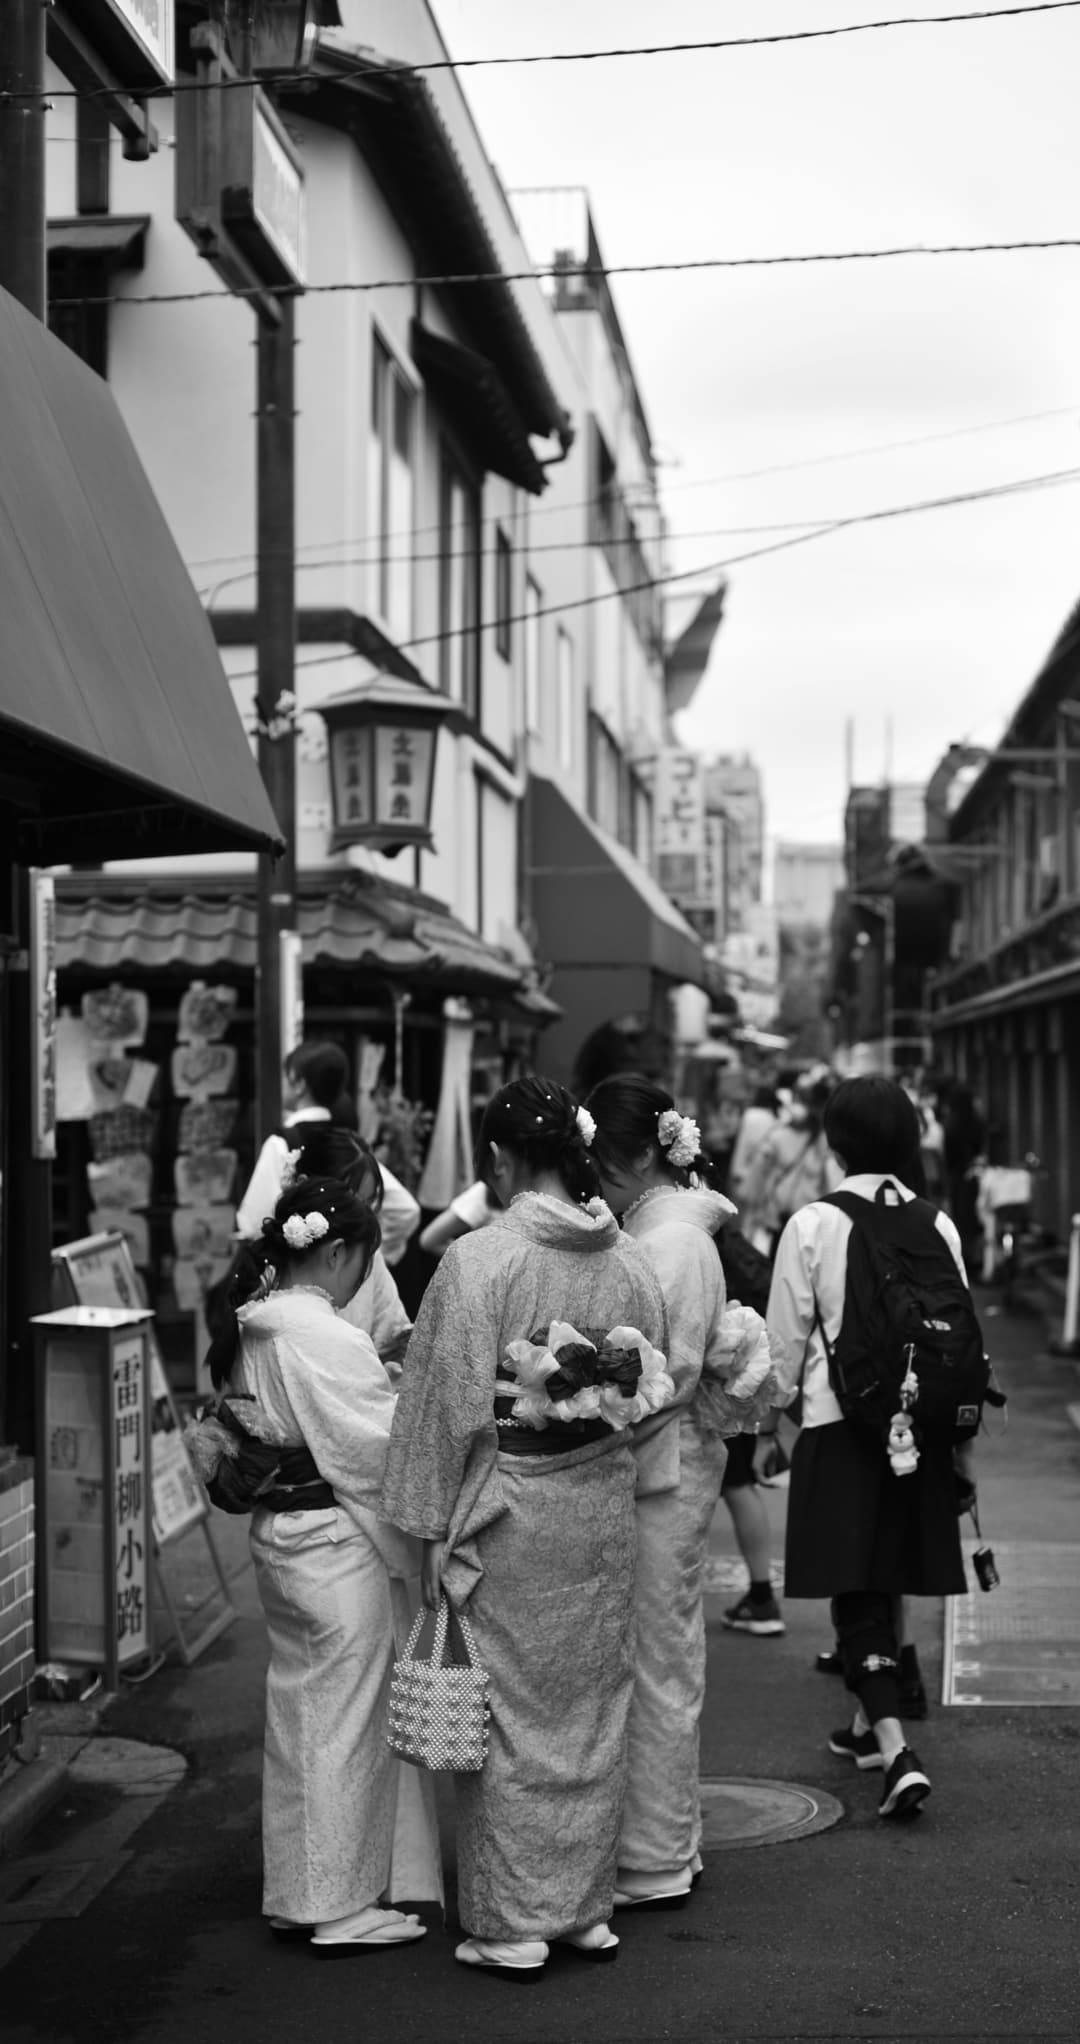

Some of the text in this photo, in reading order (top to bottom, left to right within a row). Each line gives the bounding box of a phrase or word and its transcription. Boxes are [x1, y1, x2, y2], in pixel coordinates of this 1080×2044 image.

[113, 1356, 143, 1642] 雷門柳小路
